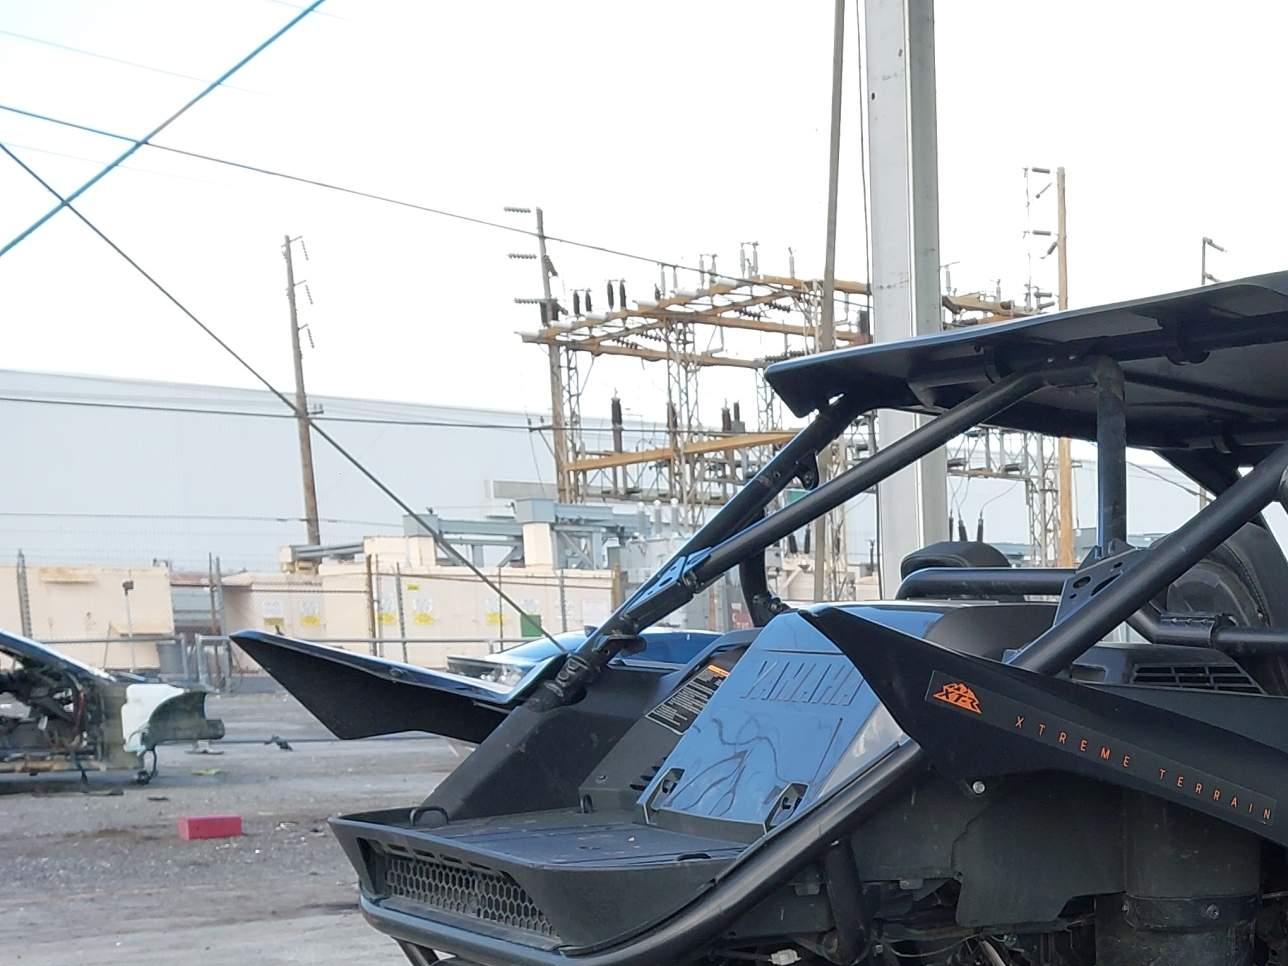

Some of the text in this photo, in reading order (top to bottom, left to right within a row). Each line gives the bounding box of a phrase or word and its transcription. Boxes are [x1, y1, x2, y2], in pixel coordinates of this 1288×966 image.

[739, 661, 865, 706] YAMAHA
[1015, 715, 1272, 821] XTREME TERRAIN
